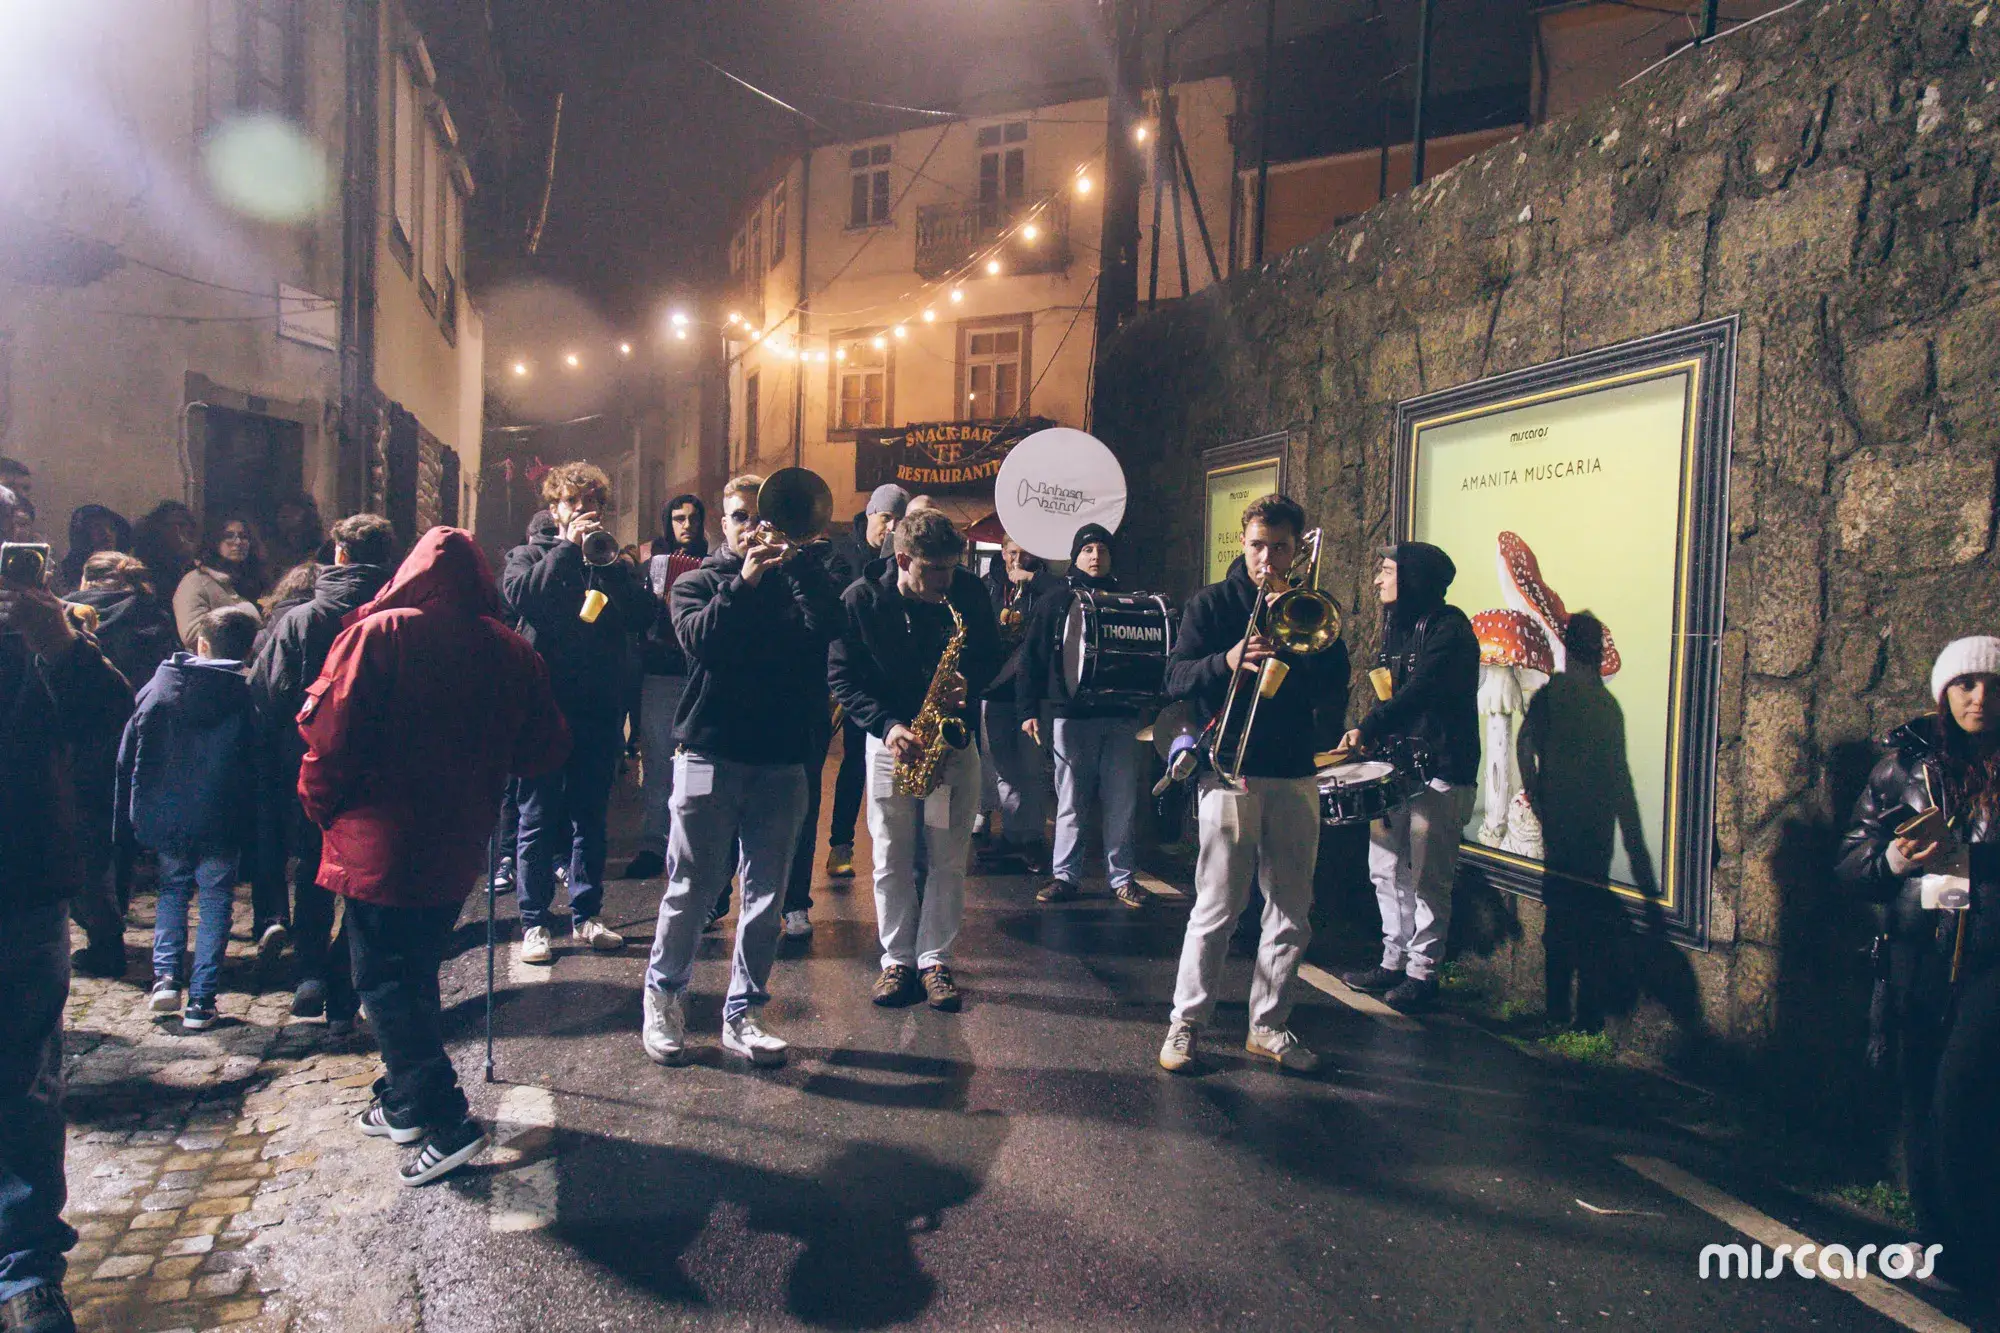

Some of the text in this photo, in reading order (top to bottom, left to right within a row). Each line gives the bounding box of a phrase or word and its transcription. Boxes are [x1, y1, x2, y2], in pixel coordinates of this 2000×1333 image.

[1510, 427, 1549, 442] miscaros
[1461, 457, 1602, 492] AMANITA MUSCARIA
[1102, 624, 1162, 641] THOMANN
